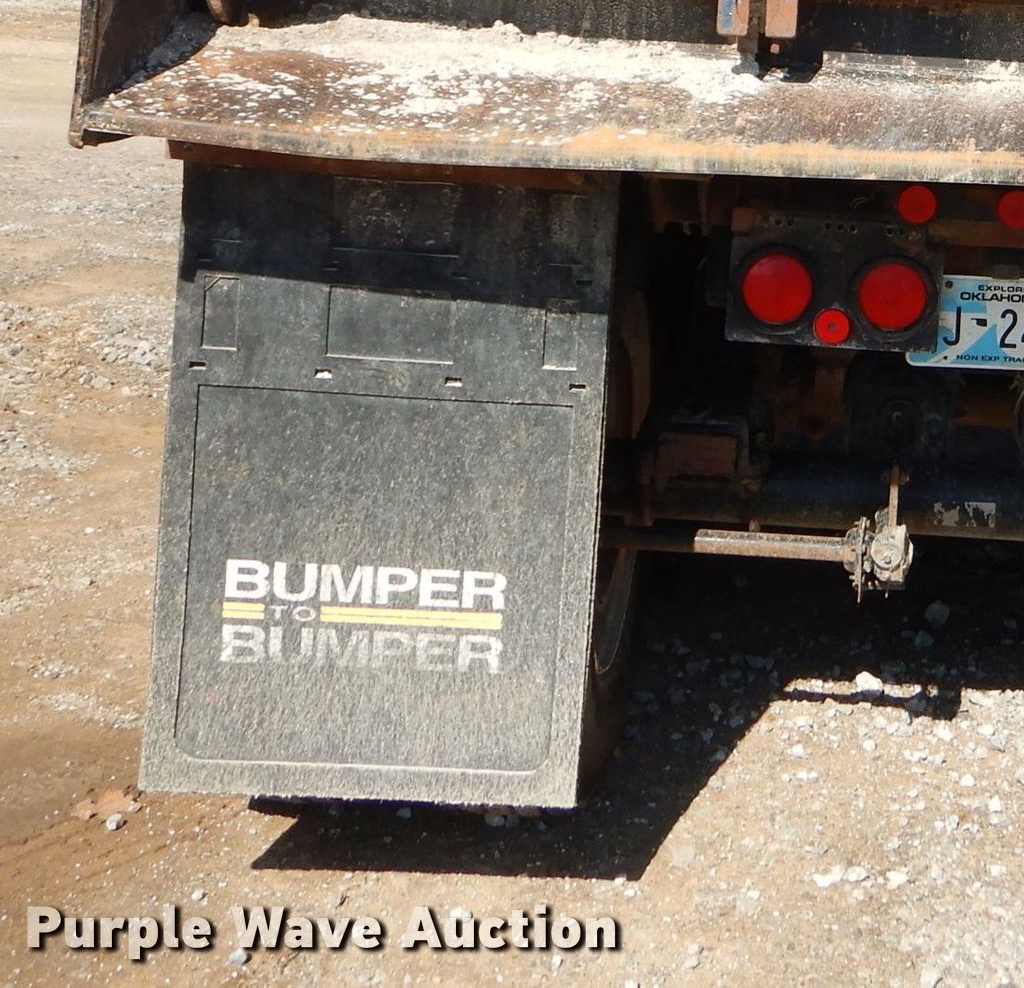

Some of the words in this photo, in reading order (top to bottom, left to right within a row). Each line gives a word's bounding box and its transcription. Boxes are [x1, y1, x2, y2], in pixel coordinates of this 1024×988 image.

[956, 354, 980, 362] NON
[224, 558, 508, 610] BUMPER
[269, 605, 316, 622] TO
